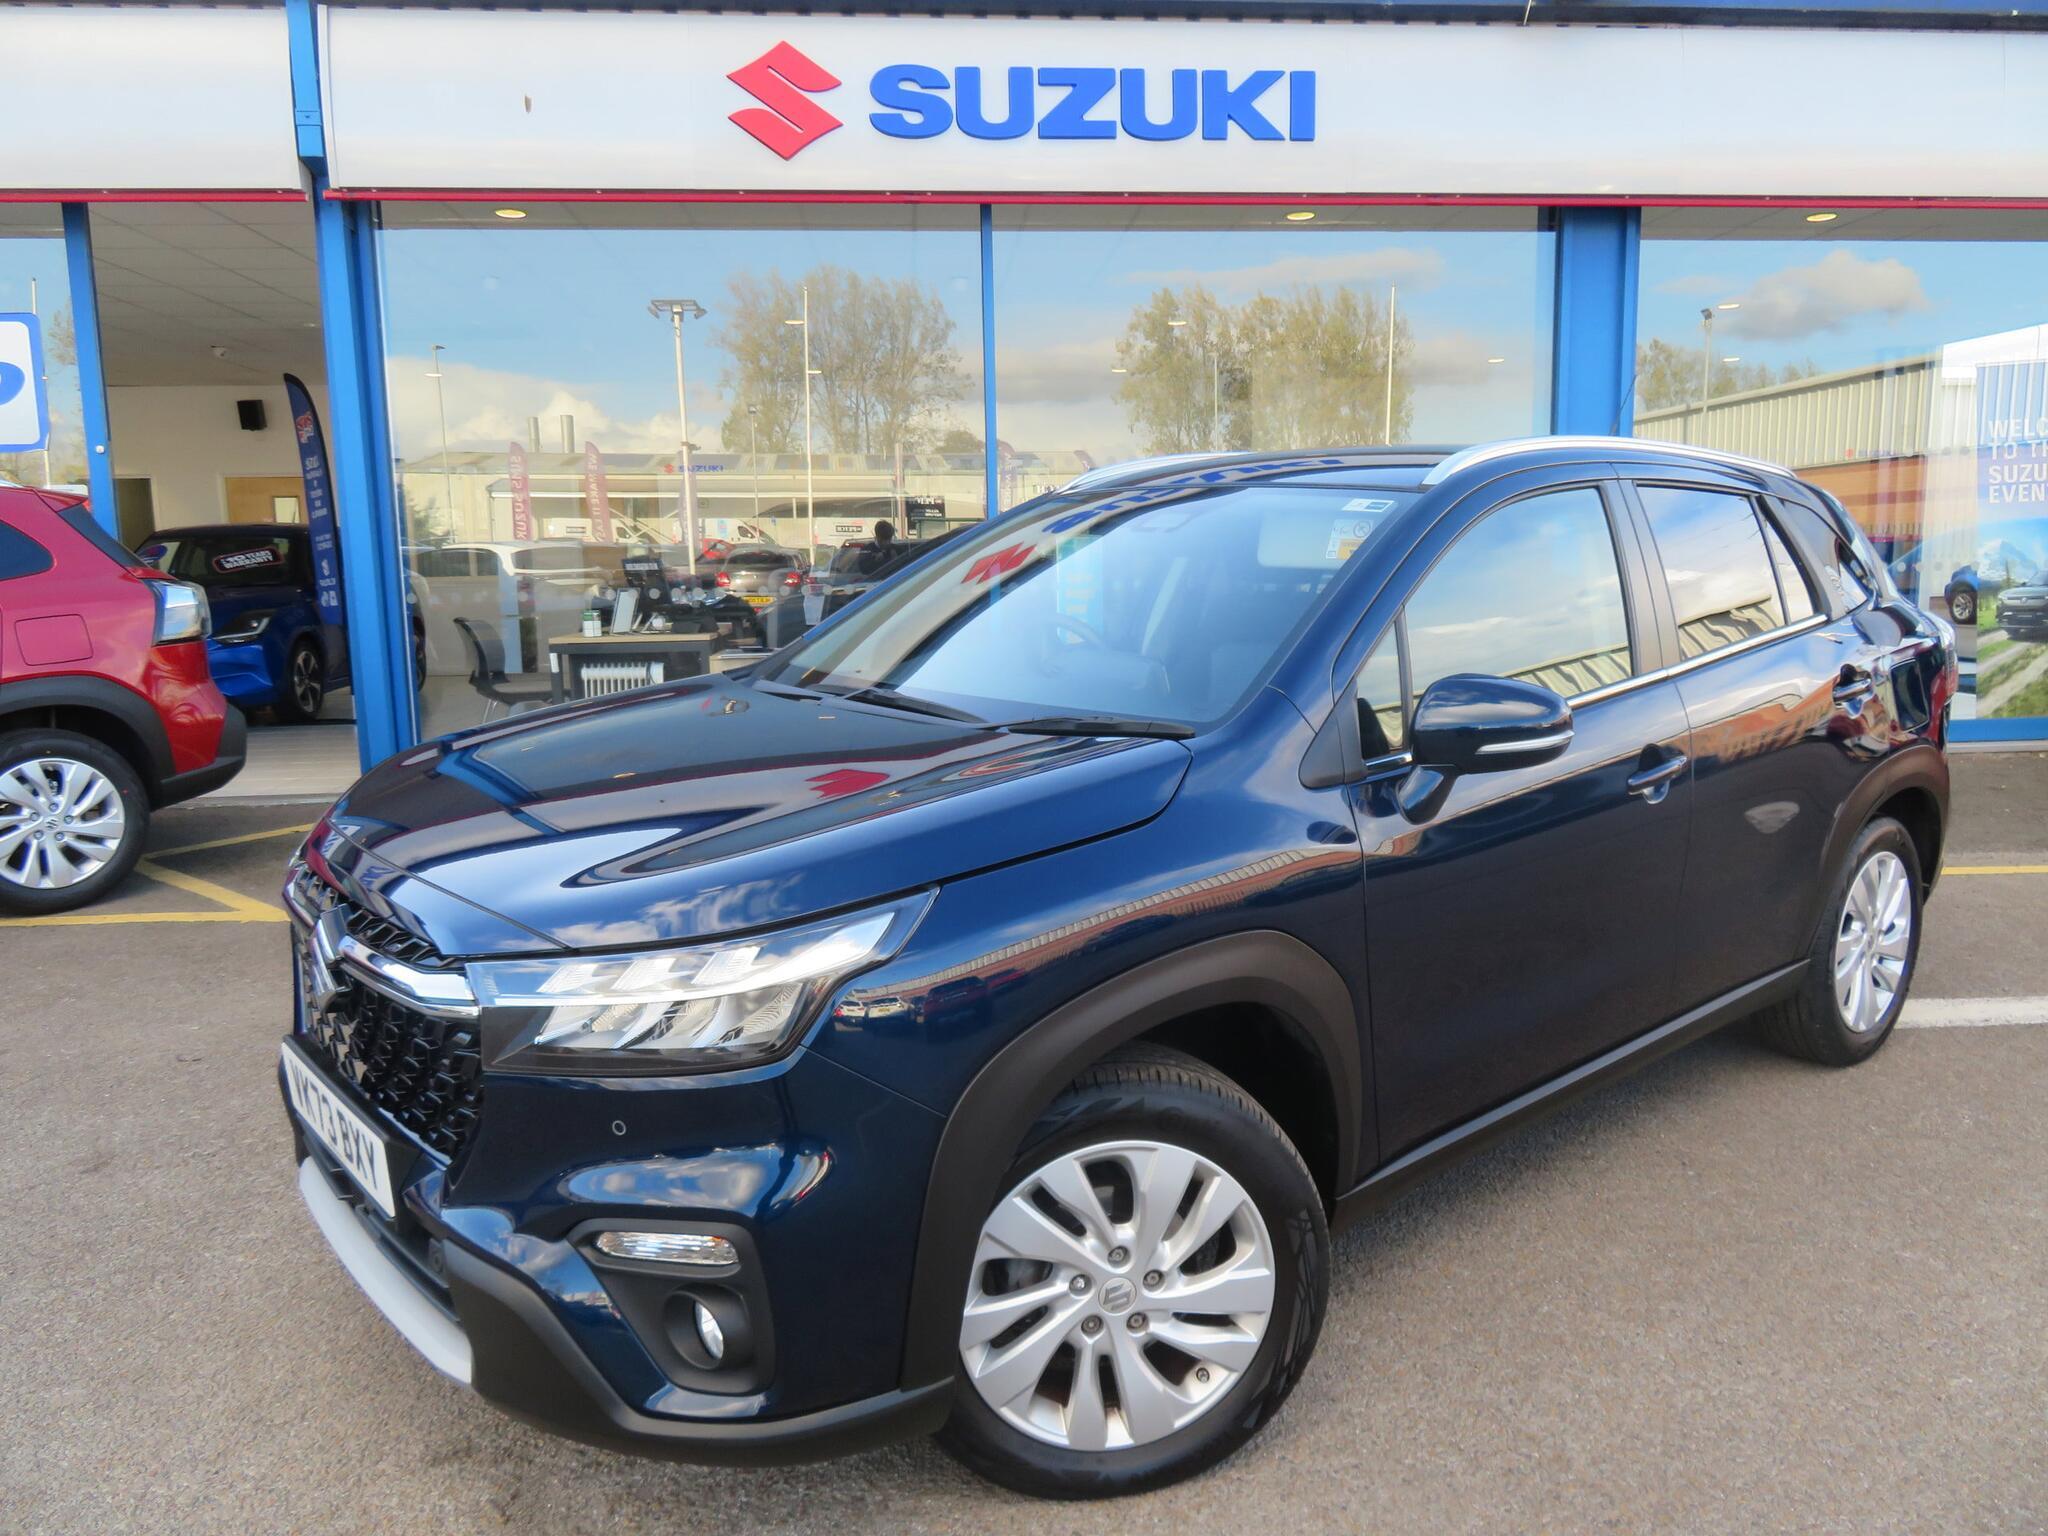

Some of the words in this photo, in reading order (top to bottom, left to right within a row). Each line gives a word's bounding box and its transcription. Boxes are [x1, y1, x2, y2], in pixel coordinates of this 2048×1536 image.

[869, 64, 1316, 141] SUZUKI
[1989, 441, 2018, 460] TO
[1988, 483, 2048, 504] EVEN
[336, 1108, 378, 1191] BXY
